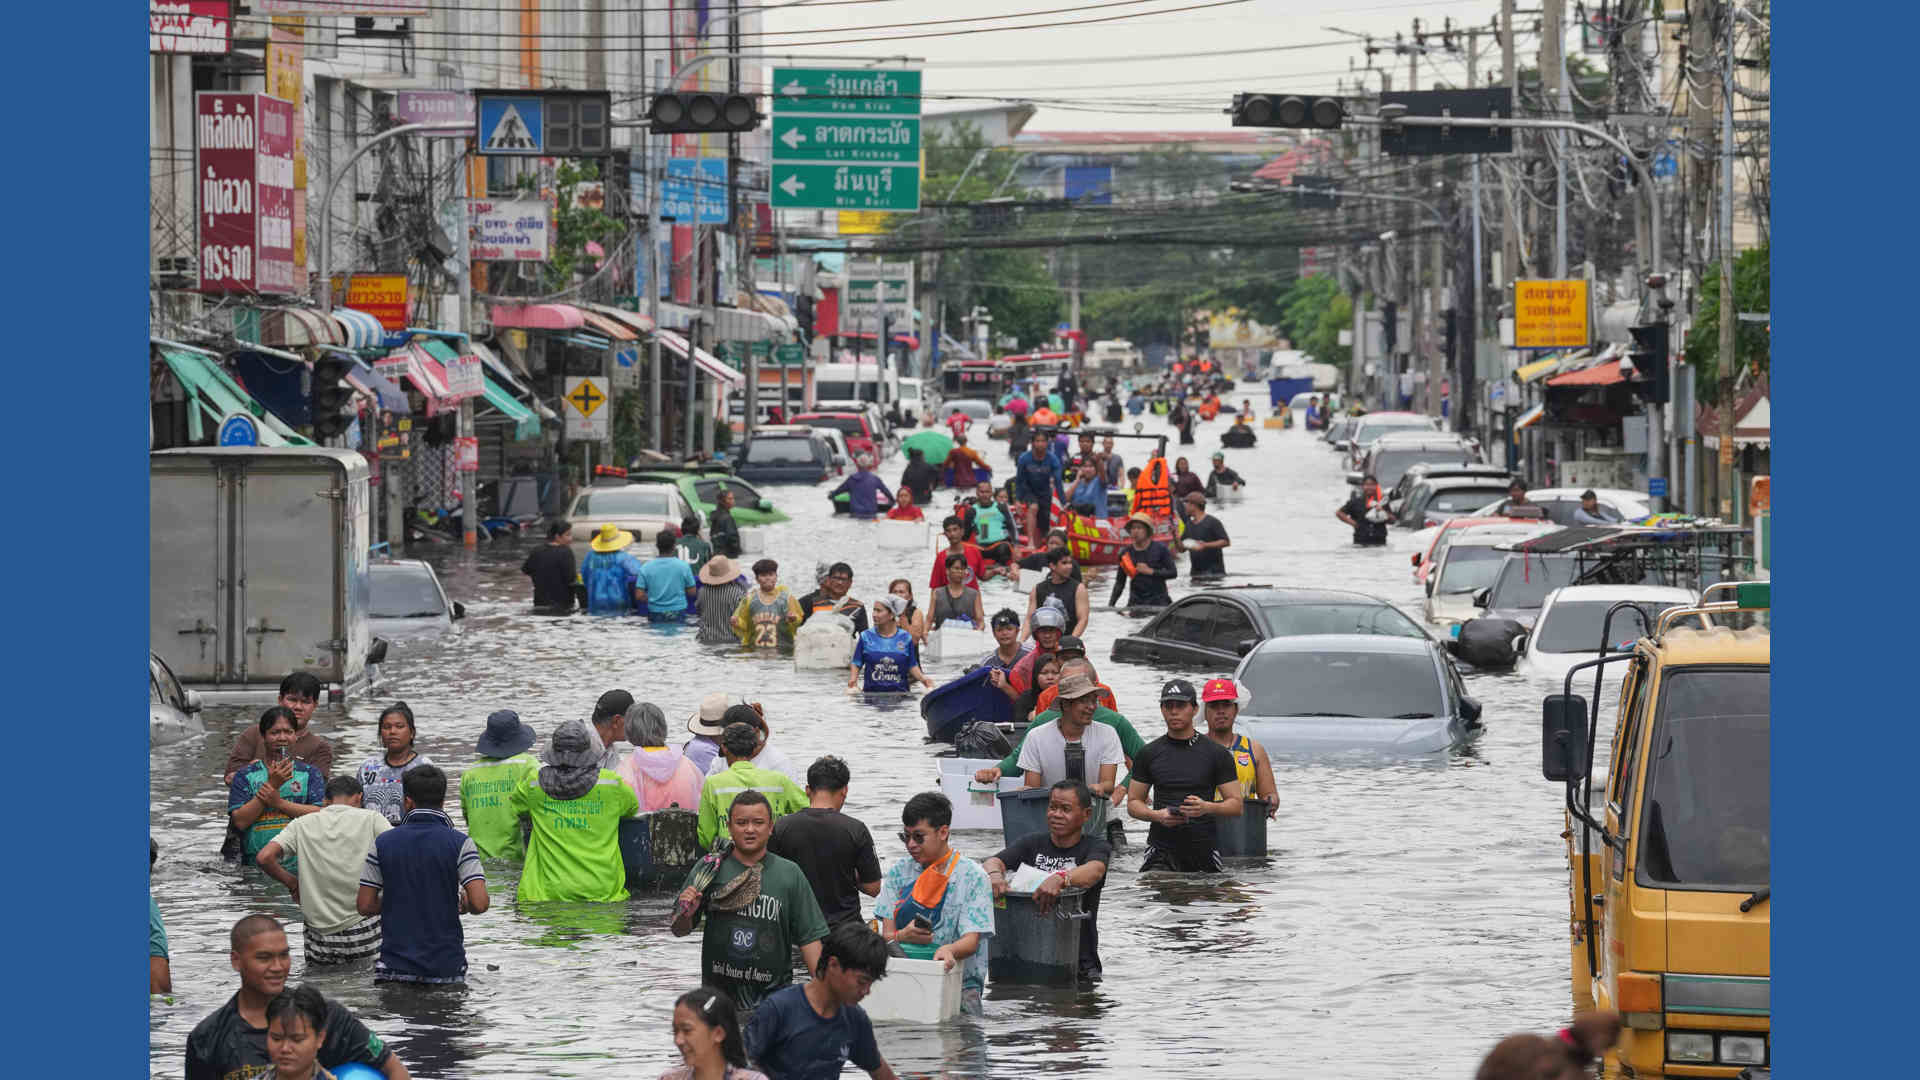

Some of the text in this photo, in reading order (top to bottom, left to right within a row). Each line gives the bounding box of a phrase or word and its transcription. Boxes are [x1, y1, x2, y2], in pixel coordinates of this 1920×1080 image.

[826, 73, 898, 97] ร่มเกล้า
[200, 99, 254, 149] เหล็กดัด
[815, 120, 911, 145] ลาดกระบัง
[834, 166, 893, 198] มีนบุรี
[203, 165, 252, 228] มุ้งลวด
[204, 244, 252, 281] กระจก
[755, 623, 777, 648] 23
[733, 929, 753, 948] DC
